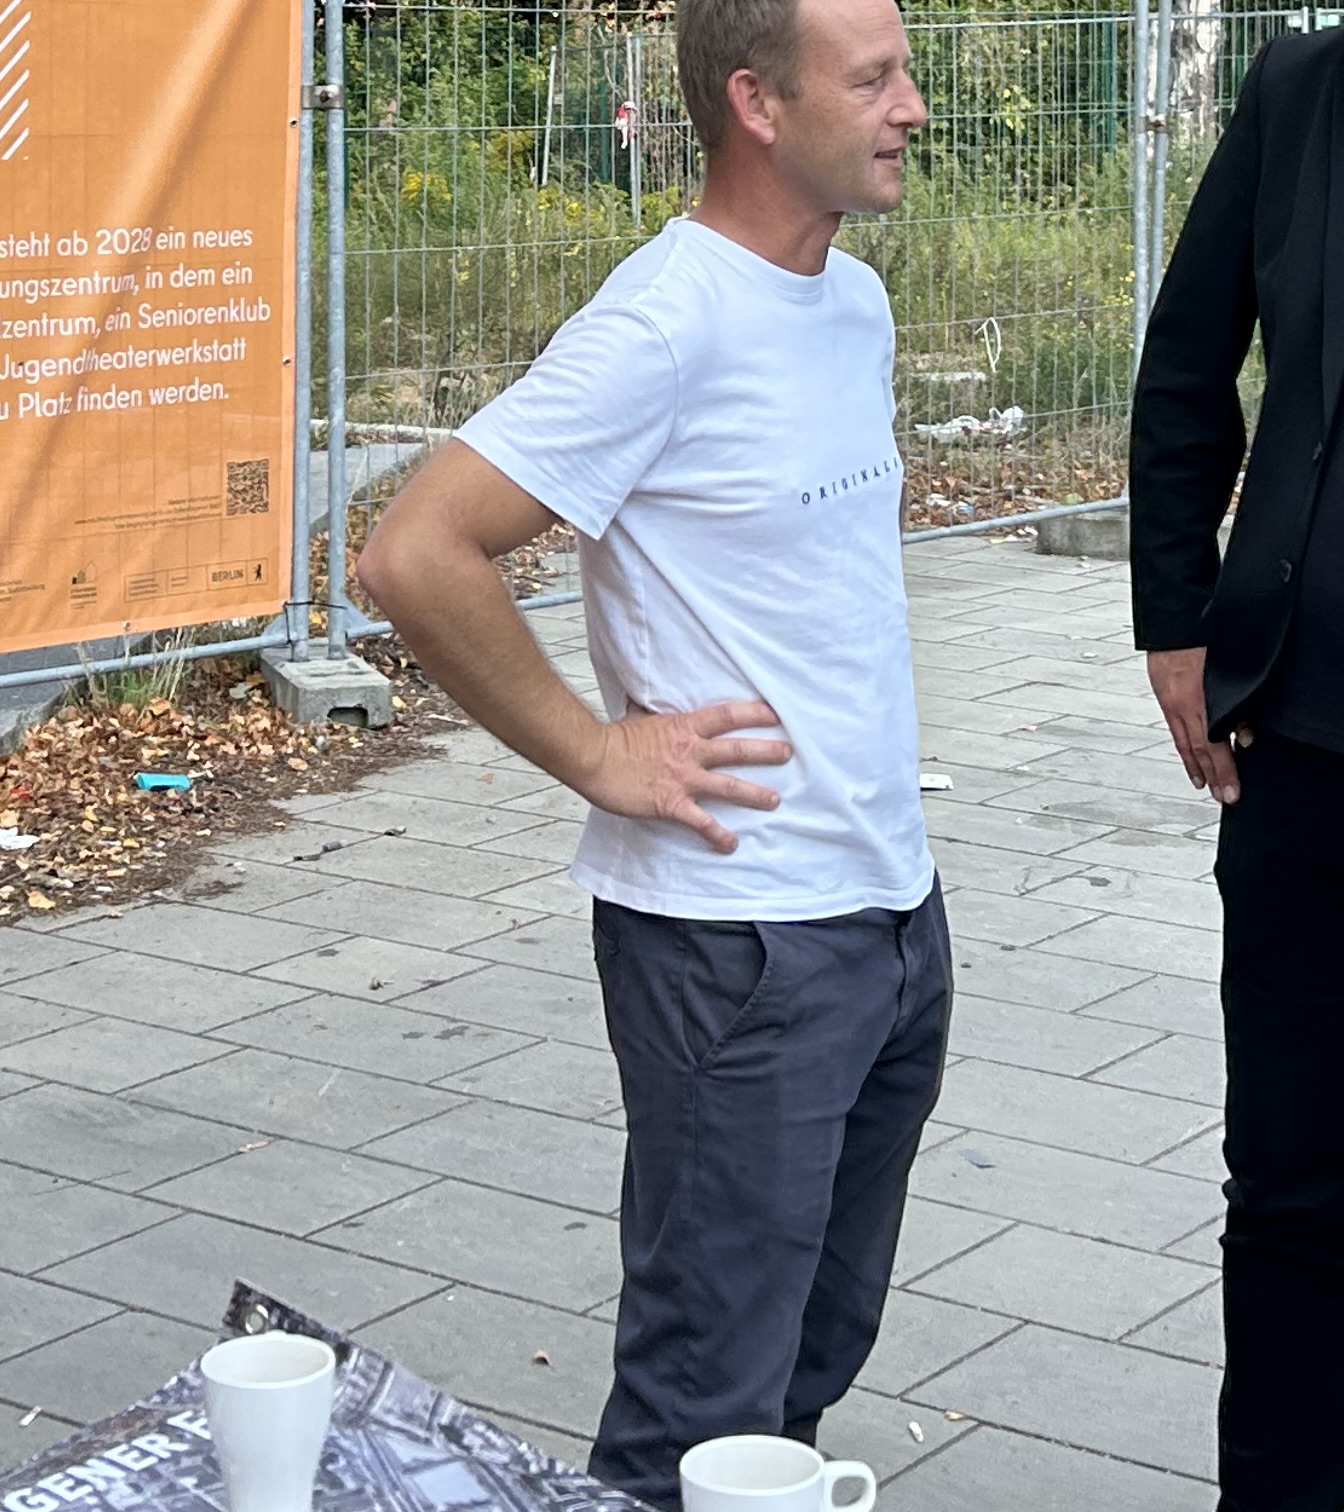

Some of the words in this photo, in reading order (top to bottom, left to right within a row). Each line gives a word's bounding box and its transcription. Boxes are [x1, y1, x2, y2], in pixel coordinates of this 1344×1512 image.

[56, 230, 89, 256] ab
[96, 226, 153, 255] 2028
[156, 226, 186, 250] ein
[192, 228, 254, 248] neues
[145, 265, 163, 289] in
[170, 262, 215, 288] dem
[222, 260, 253, 284] ein
[105, 307, 131, 331] ein
[138, 296, 271, 329] Seniorenklub
[18, 390, 73, 419] Platz
[77, 383, 143, 412] finden
[148, 376, 230, 405] werden.
